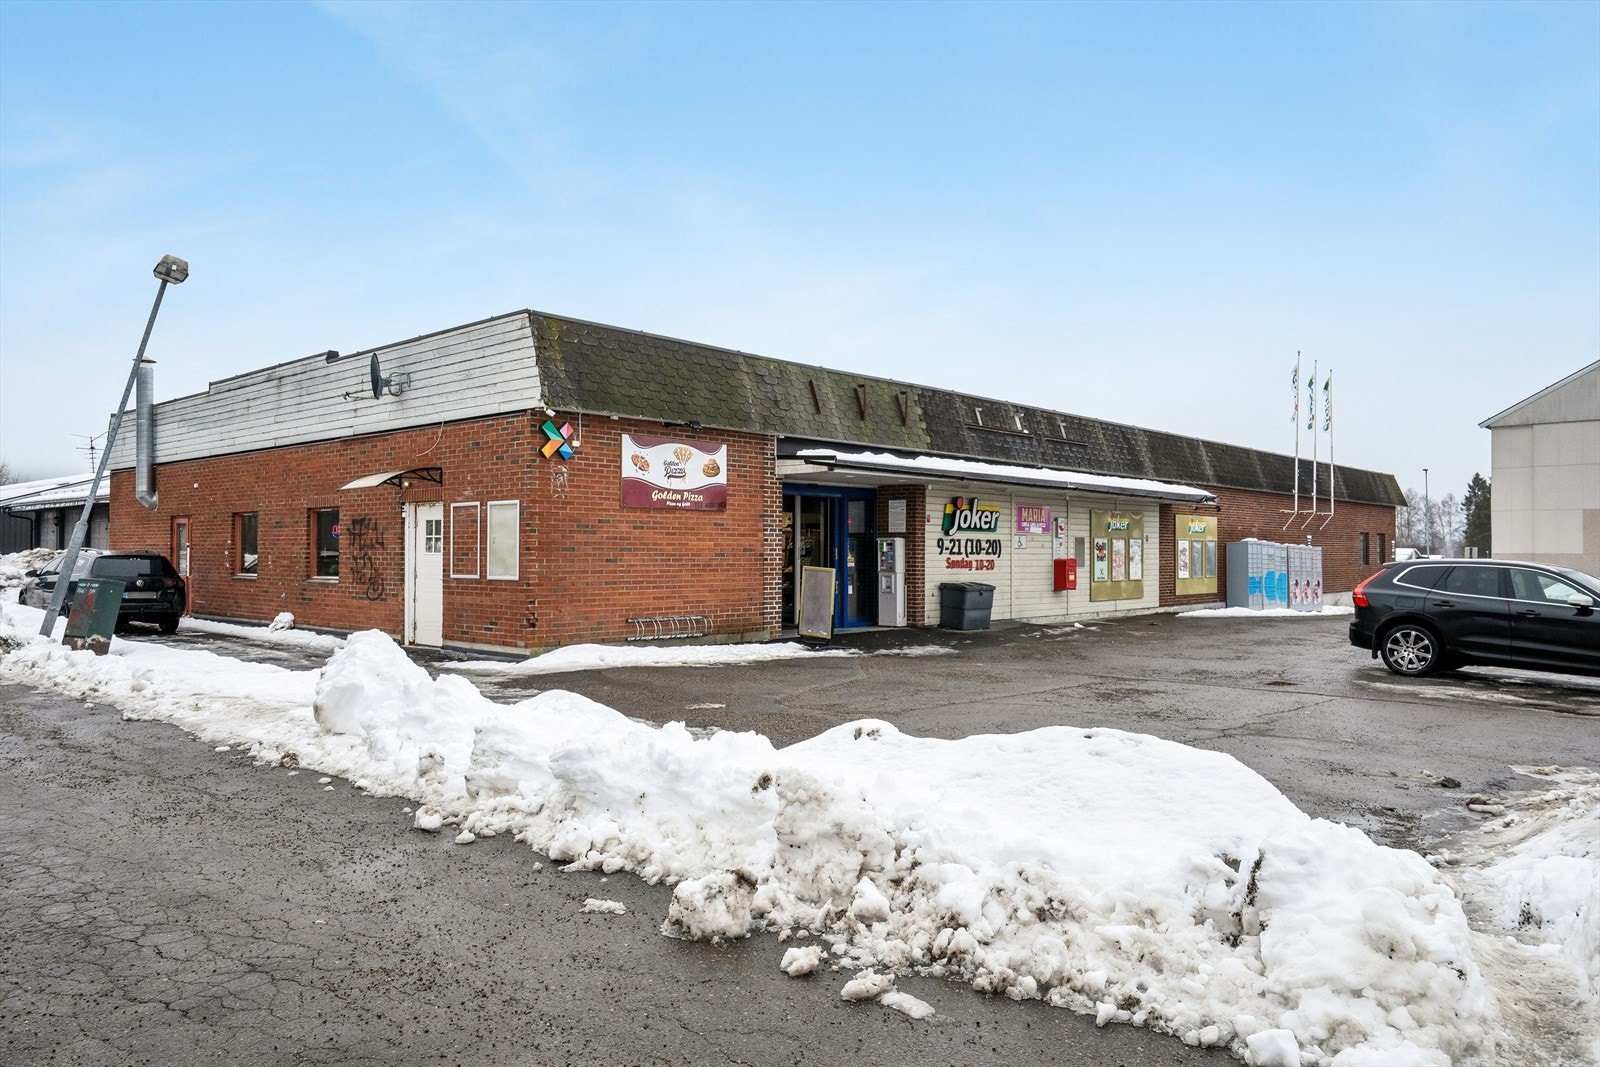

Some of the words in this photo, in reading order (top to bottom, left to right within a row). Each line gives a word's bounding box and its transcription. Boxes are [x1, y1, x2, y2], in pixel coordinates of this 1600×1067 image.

[664, 466, 686, 477] Pizza
[652, 490, 681, 501] Golden
[683, 492, 703, 502] Pizza
[948, 497, 1000, 535] joker
[1021, 508, 1046, 522] MARIA
[1108, 513, 1129, 532] joker
[1188, 518, 1206, 534] joker
[936, 538, 963, 555] 9-21
[964, 538, 1002, 558] (10-20)
[946, 557, 973, 571] Søndag
[975, 559, 995, 570] 10-20
